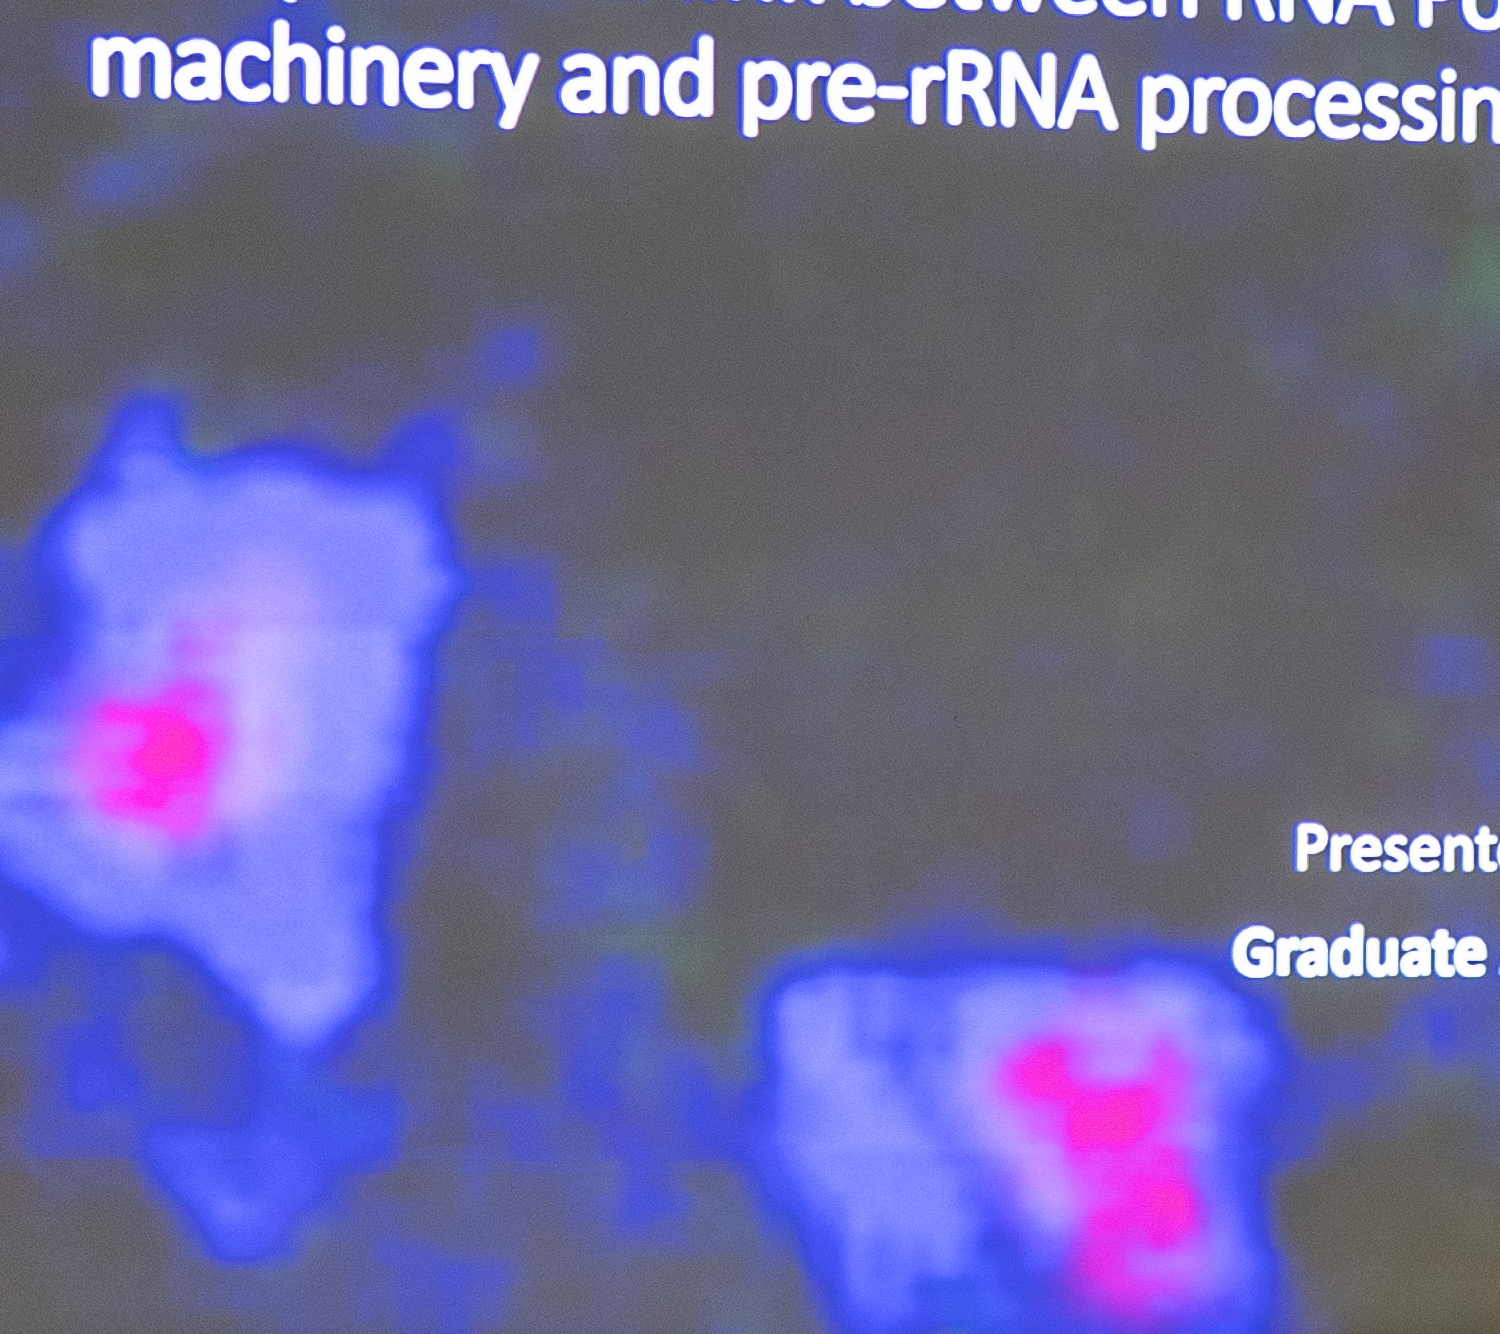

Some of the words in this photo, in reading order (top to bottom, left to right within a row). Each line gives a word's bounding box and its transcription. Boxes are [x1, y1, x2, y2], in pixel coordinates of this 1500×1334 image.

[91, 18, 541, 131] machinery
[559, 33, 716, 119] and
[741, 47, 1121, 139] pre-rRNA
[1231, 923, 1489, 979] Graduate
